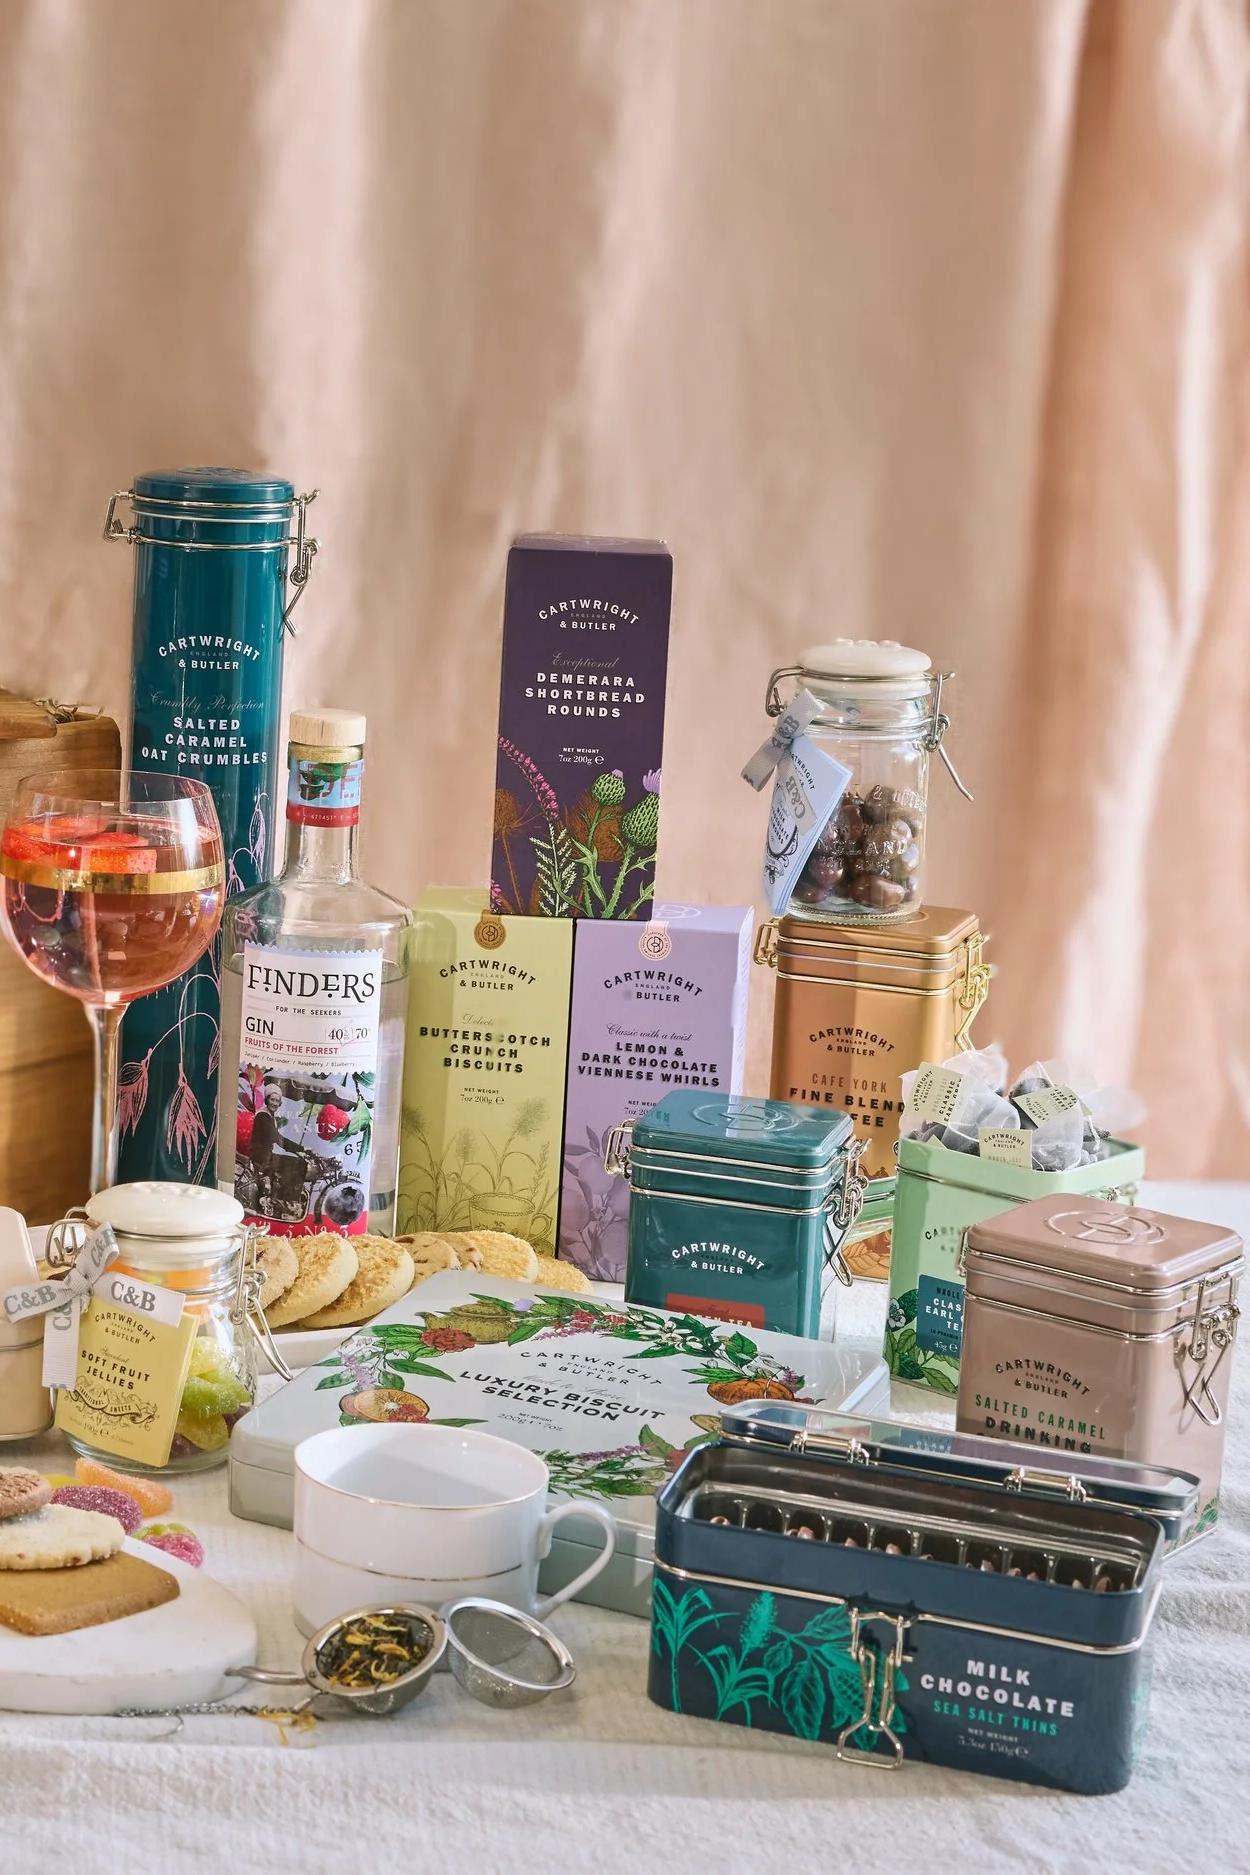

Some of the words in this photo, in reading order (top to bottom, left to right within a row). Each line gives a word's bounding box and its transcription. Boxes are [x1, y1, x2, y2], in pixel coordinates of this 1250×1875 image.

[538, 599, 639, 624] CARTWRIGHT
[572, 621, 616, 630] BUTLER
[158, 636, 260, 660] CARTWRIGHT
[192, 661, 239, 669] BUTLER
[551, 653, 619, 671] Exceptional
[537, 673, 634, 687] DEMERARA
[525, 688, 645, 703] SHORTBREAD
[548, 705, 621, 718] ROUNDS
[174, 717, 240, 730] SALTED
[165, 734, 247, 747] CARAMEL
[141, 748, 167, 760] OAT
[178, 752, 267, 764] CRUMBLES
[785, 776, 806, 819] C&B
[440, 960, 536, 985] CARTWRIGHT
[247, 964, 375, 1003] FINDERS
[472, 981, 514, 991] BUTLER
[604, 970, 703, 997] CARTWRIGHT
[636, 992, 680, 1002] BUTLER
[245, 1016, 274, 1036] GIN
[328, 1028, 344, 1040] 40
[355, 1028, 368, 1039] 70
[244, 1037, 271, 1049] FRUITS
[272, 1043, 284, 1051] OF
[286, 1045, 303, 1054] THE
[305, 1046, 339, 1055] FOREST
[450, 1044, 518, 1058] CRUNCH
[617, 1042, 667, 1055] LEMON
[809, 1028, 894, 1053] CARTWRIGHT
[837, 1045, 875, 1057] BUTLER
[444, 1058, 523, 1073] BISCUITS
[582, 1053, 622, 1064] DARK
[628, 1057, 717, 1073] CHOCOLATE
[578, 1066, 654, 1081] VIENNESE
[661, 1073, 720, 1087] WHIRLS
[812, 1073, 844, 1088] CAFE
[853, 1081, 887, 1093] YORK
[789, 1087, 834, 1103] FINE
[845, 1095, 905, 1112] BLEND
[914, 1070, 934, 1112] CARTWRIGHT
[939, 1080, 956, 1115] CLASSIC
[944, 1102, 955, 1122] EARL
[984, 1133, 1025, 1146] CARTWRIGHT
[672, 1242, 765, 1270] CARTWRIGHT
[702, 1262, 743, 1274] BUTLER
[3, 1285, 56, 1315] C&B
[111, 1281, 156, 1312] C&B
[926, 1306, 953, 1320] EARL
[95, 1312, 156, 1343] CARTWRIGHT
[112, 1330, 140, 1344] BUTLER
[81, 1350, 107, 1366] SOFT
[112, 1363, 150, 1382] FRUIT
[520, 1351, 661, 1384] CARTWRIGHT
[558, 1366, 630, 1385] BUTLER
[86, 1366, 135, 1390] JELLIES
[995, 1359, 1091, 1396] CARTWRIGHT
[459, 1370, 557, 1396] LUXURY
[564, 1391, 665, 1419] BISCUIT
[1025, 1380, 1068, 1398] BUTLER
[481, 1386, 620, 1421] SELECTION
[975, 1394, 1028, 1419] SALTED
[1038, 1411, 1106, 1440] CARAMEL
[985, 1416, 1091, 1454] DRINKING
[967, 1660, 1030, 1686] MILK
[920, 1674, 1075, 1717] CHOCOLATE
[934, 1700, 960, 1717] SEA
[968, 1706, 1003, 1725] SALT
[1013, 1716, 1058, 1736] THINS
[968, 1727, 984, 1736] NET
[987, 1731, 1018, 1743] WEIGHT
